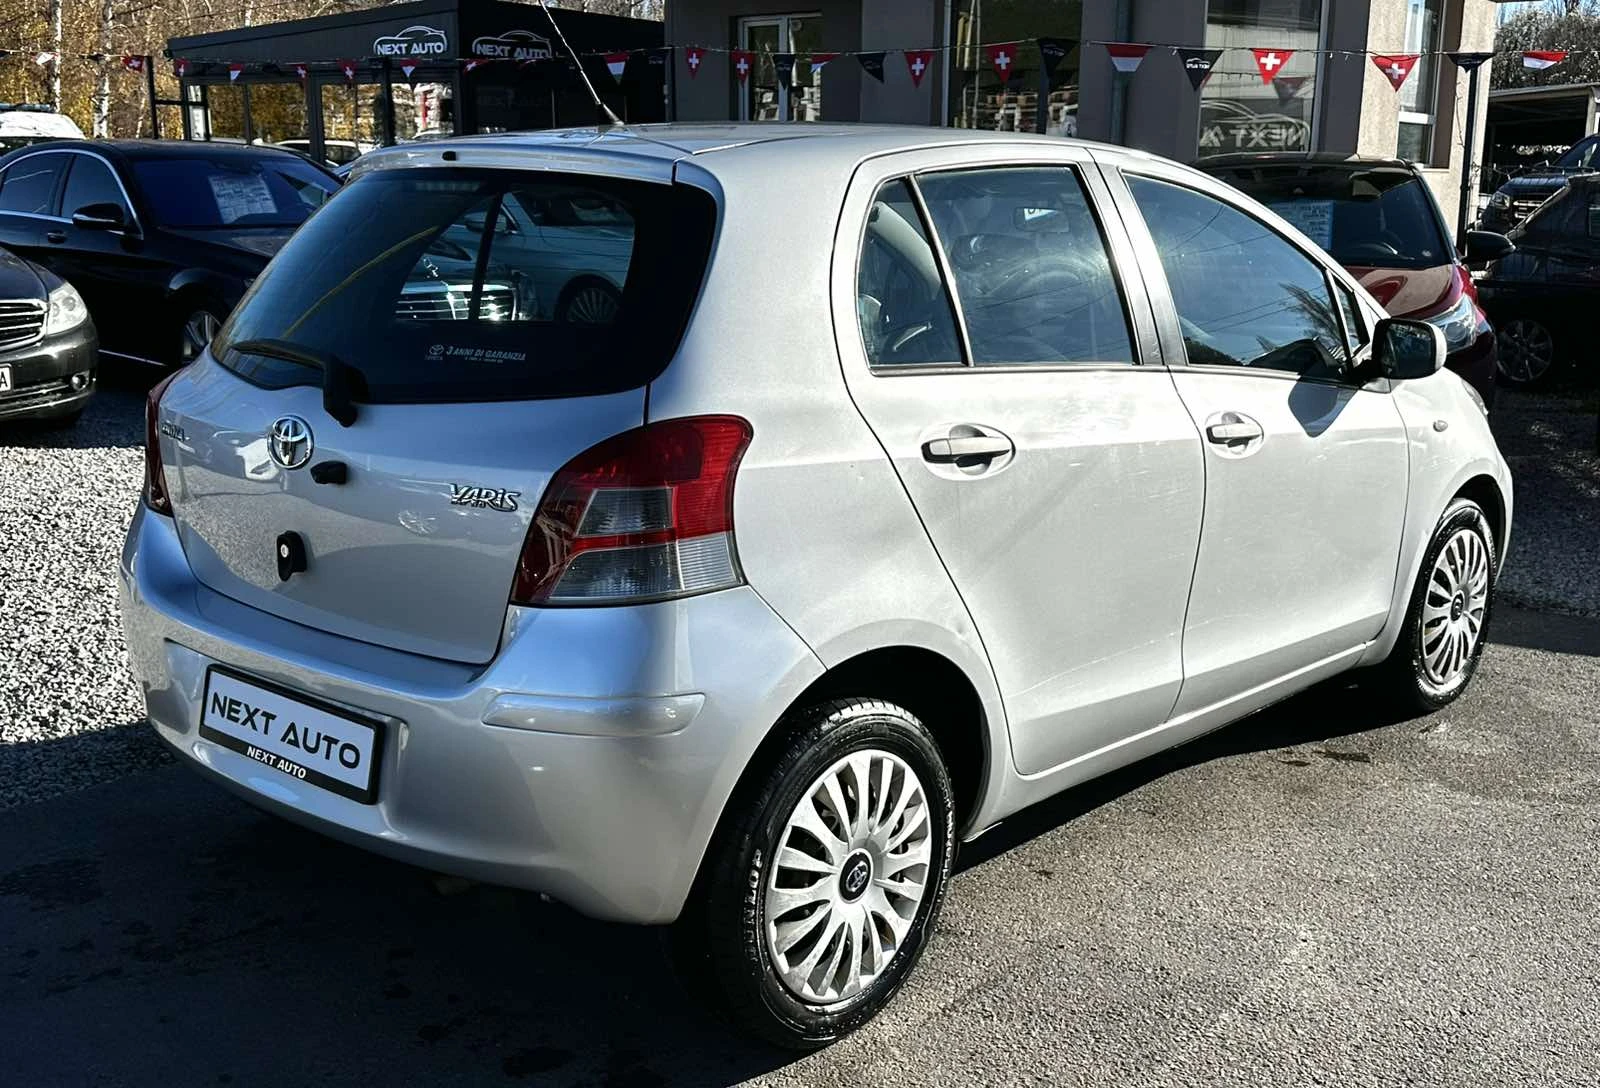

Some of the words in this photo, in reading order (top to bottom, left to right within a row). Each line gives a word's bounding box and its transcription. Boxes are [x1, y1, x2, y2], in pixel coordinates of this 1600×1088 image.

[377, 43, 408, 55] NEXT
[410, 42, 444, 54] AUTO
[476, 43, 511, 57] NEXT
[513, 47, 549, 59] AUTO
[445, 345, 453, 355] 3
[453, 348, 474, 356] ANNI
[485, 350, 526, 361] GARANZIA
[211, 692, 277, 735] NEXT
[280, 722, 360, 769] AUTO
[247, 746, 277, 766] NEXT
[277, 759, 306, 779] AUTO
